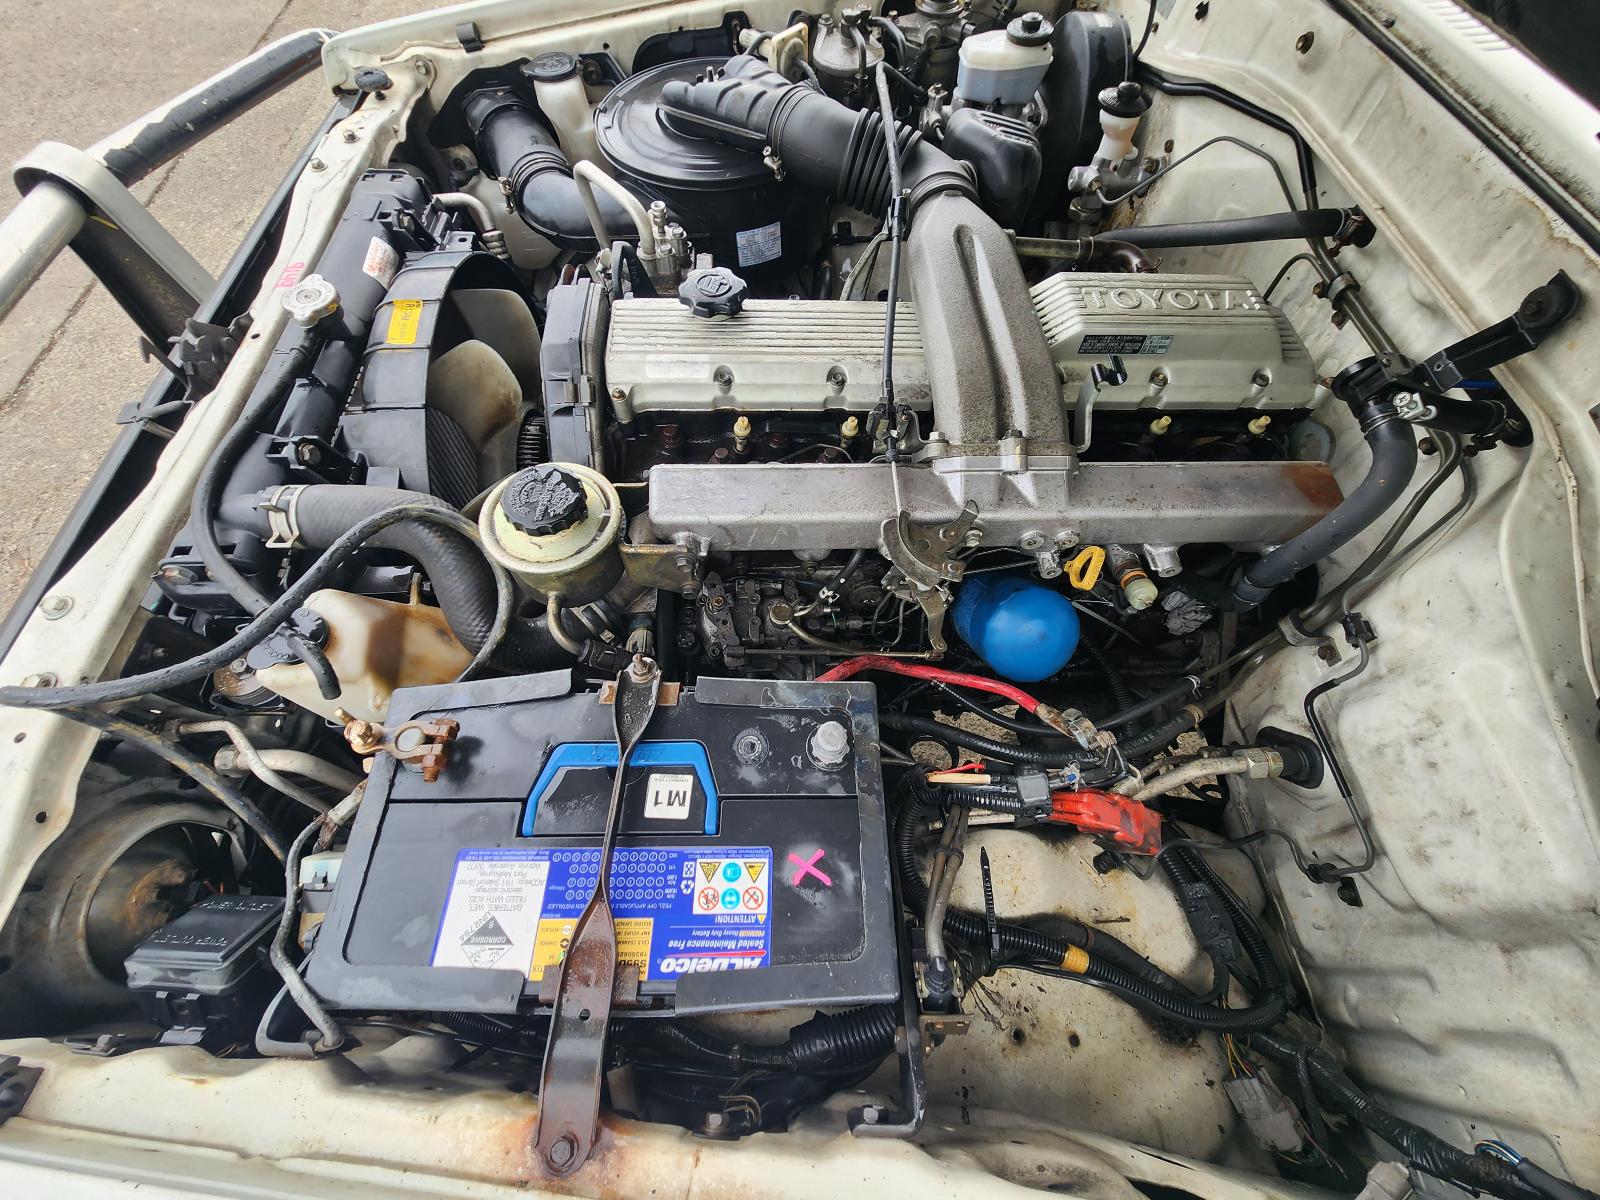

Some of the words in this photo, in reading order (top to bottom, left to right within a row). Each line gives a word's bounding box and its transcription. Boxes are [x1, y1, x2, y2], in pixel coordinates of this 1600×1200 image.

[1083, 287, 1252, 311] TOYOTA
[654, 789, 687, 808] M1
[715, 914, 757, 924] ATTENTION!
[458, 911, 492, 941] UN2794
[469, 936, 507, 944] CORROSIVE
[667, 939, 686, 950] Free
[686, 939, 737, 950] Maintenance
[738, 939, 765, 950] Sealed
